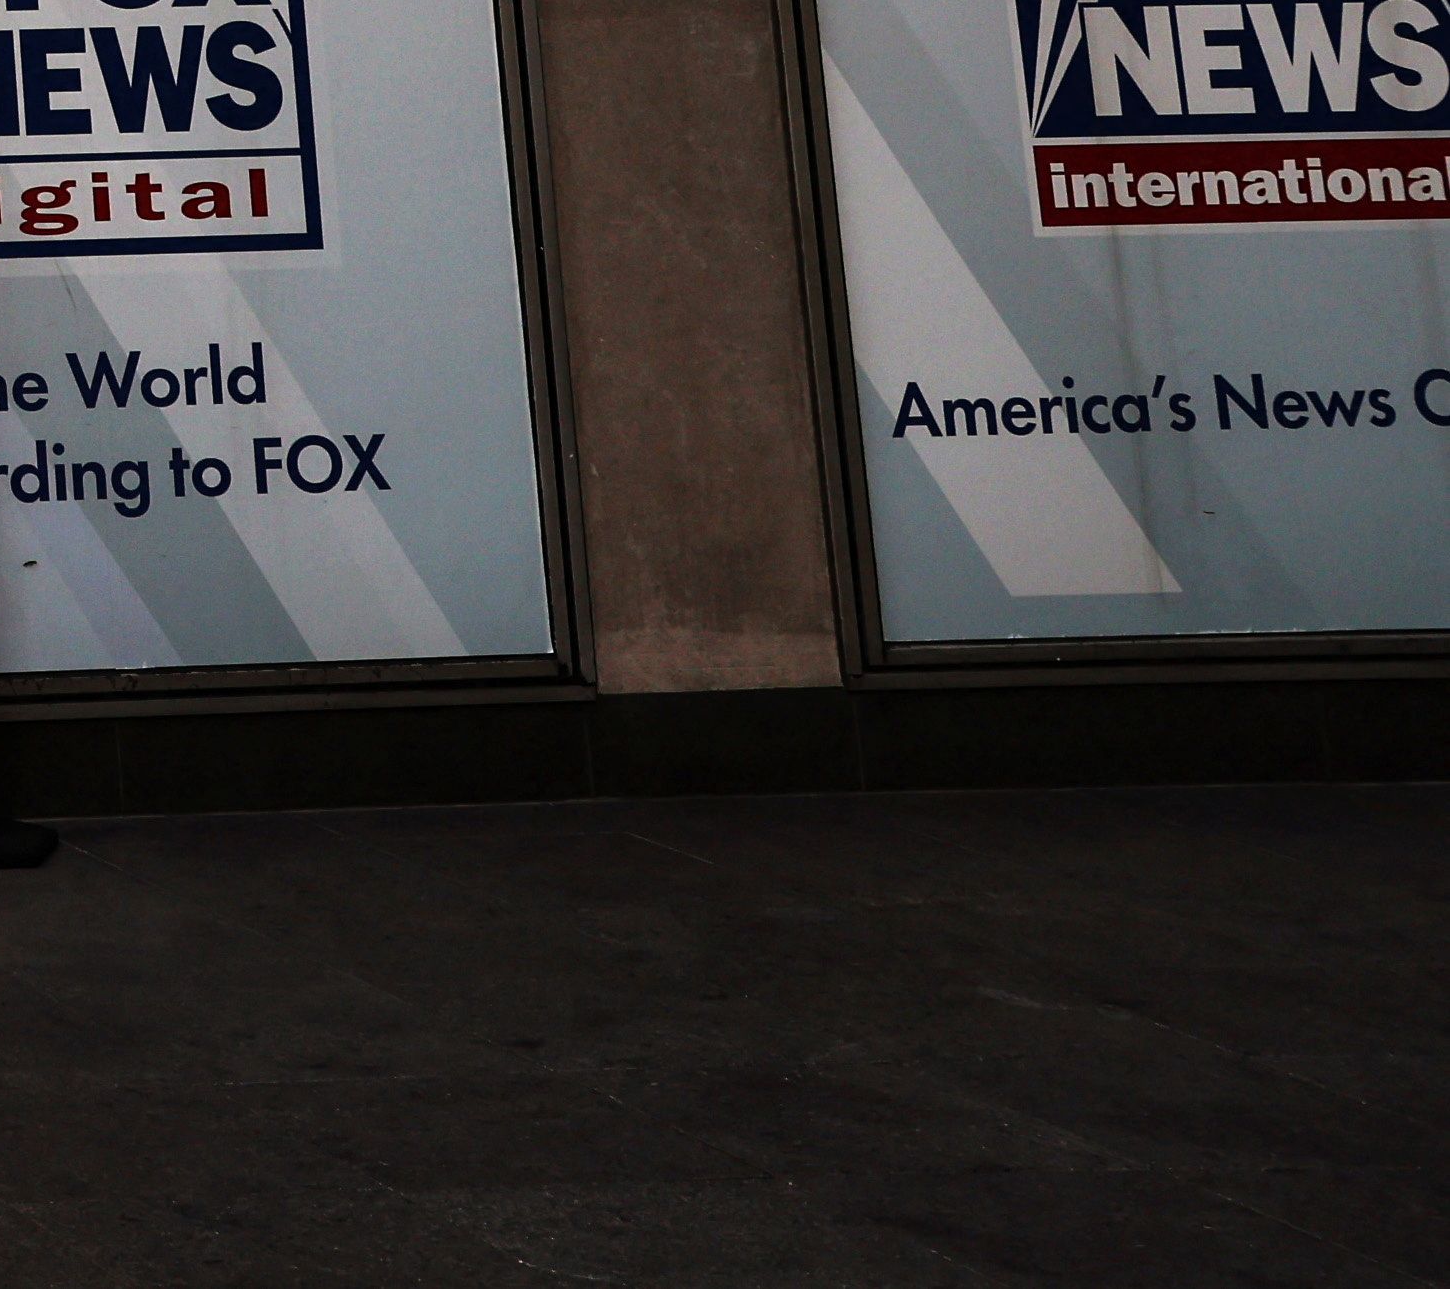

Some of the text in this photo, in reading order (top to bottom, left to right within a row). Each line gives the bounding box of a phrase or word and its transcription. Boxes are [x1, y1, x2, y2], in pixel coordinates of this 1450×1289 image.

[1051, 153, 1450, 209] internationa
[66, 343, 267, 409] World
[892, 375, 1197, 439] America's
[1213, 373, 1396, 431] News
[167, 446, 232, 499] to
[253, 434, 392, 495] FOX
